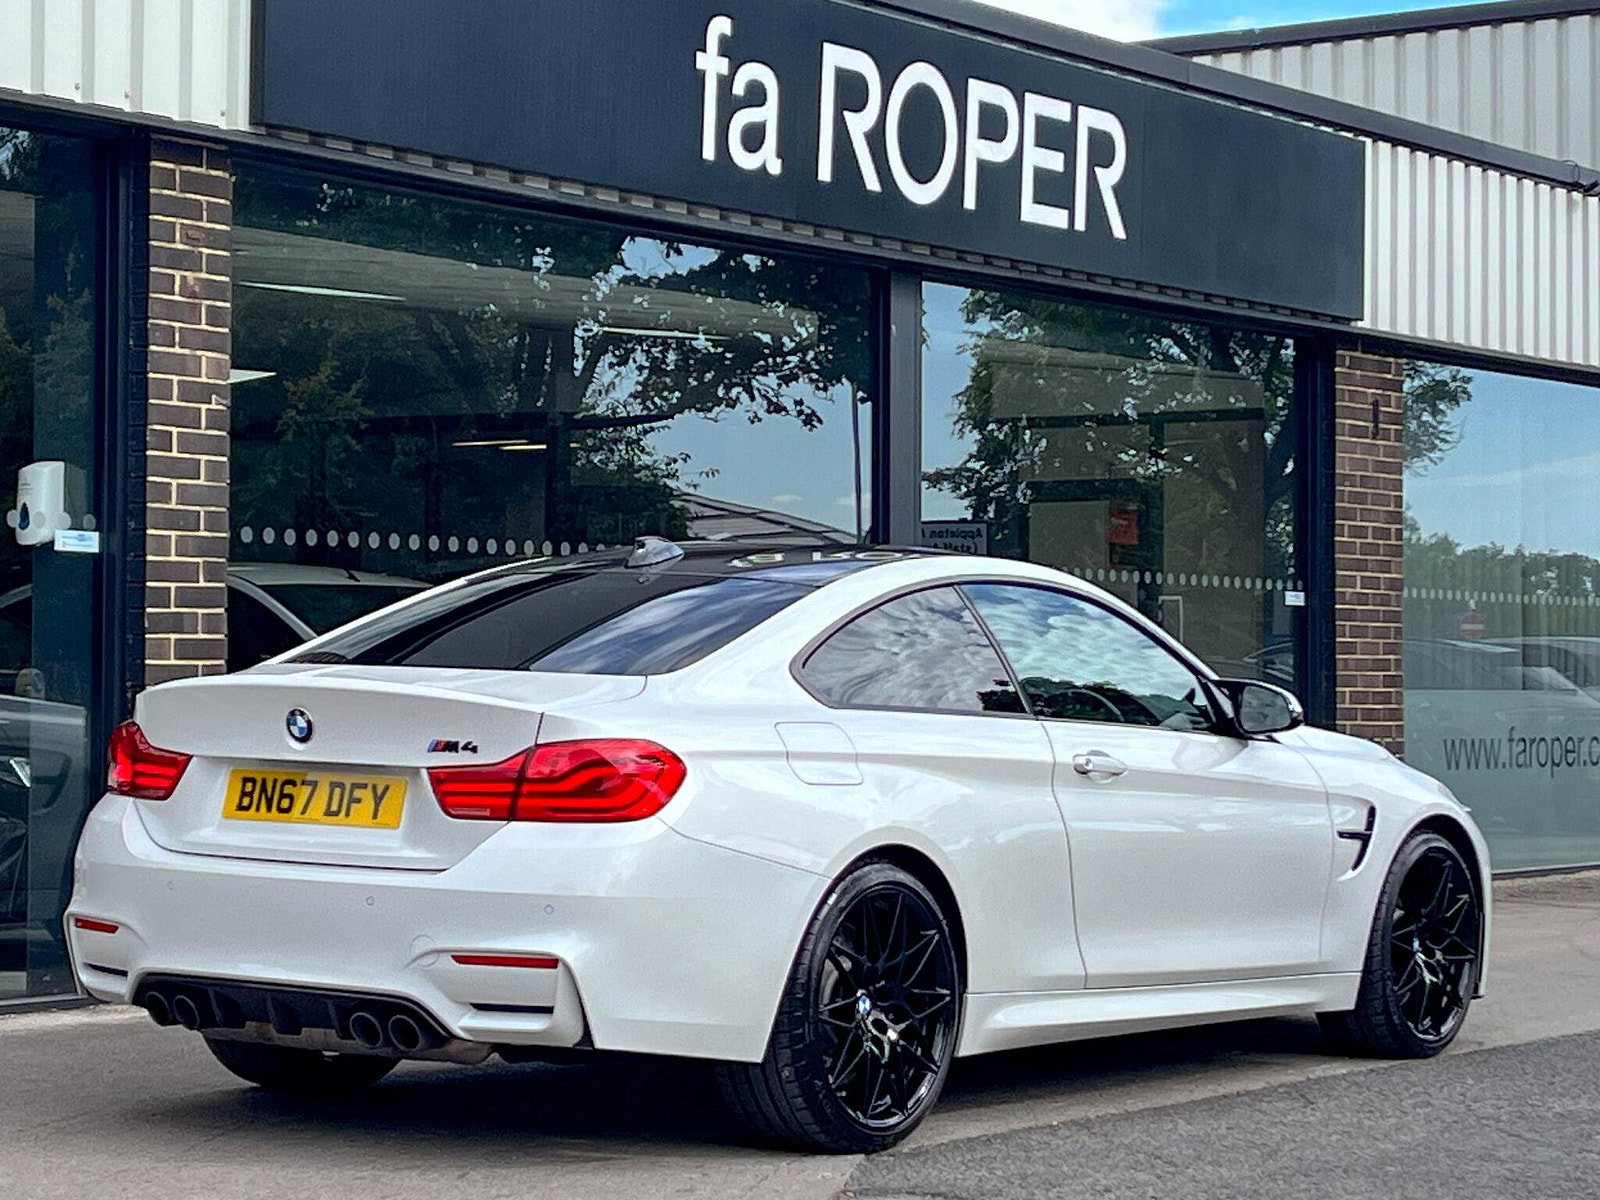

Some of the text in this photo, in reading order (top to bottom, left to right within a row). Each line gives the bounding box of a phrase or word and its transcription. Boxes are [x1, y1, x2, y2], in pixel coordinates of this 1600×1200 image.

[695, 14, 1127, 240] fa ROPER
[427, 739, 478, 754] M4
[235, 776, 390, 820] BN67 DFY
